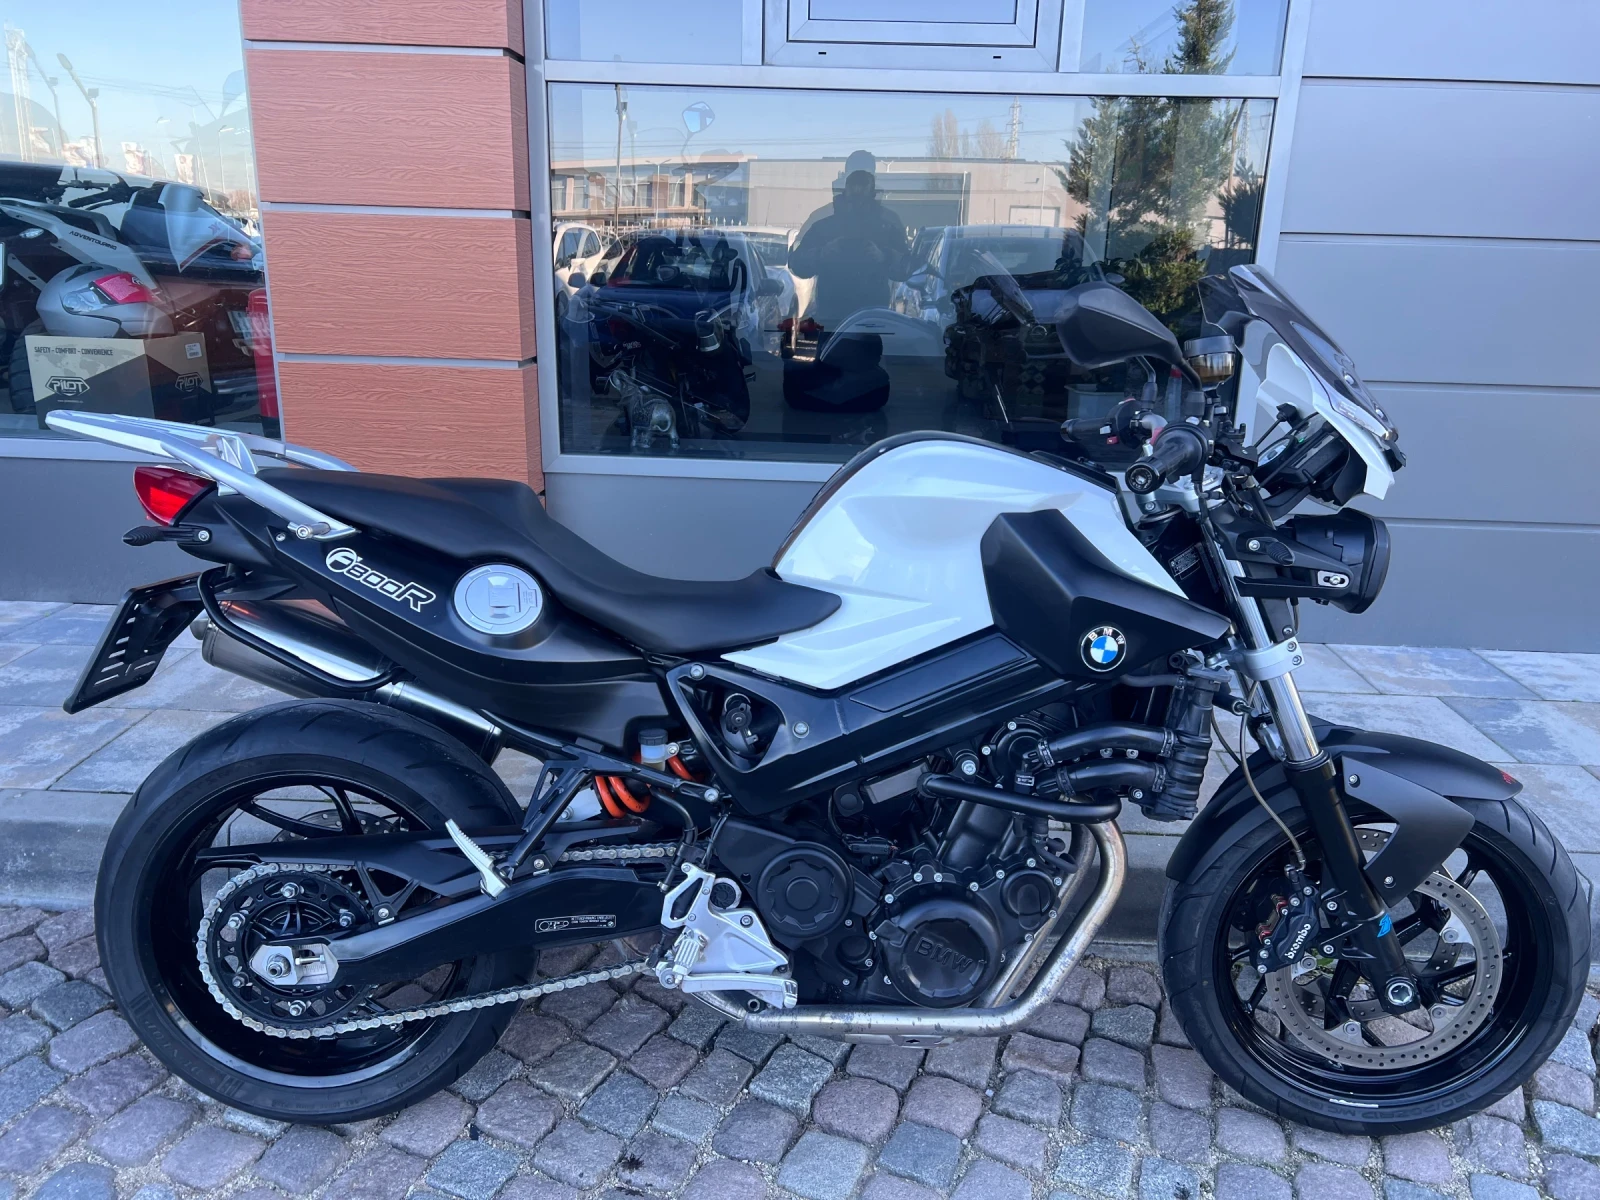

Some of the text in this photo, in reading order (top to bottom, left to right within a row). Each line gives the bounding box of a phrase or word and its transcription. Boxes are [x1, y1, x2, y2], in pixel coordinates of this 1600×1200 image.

[69, 230, 117, 250] ADVENTOURING
[34, 346, 51, 354] SAFETY
[55, 347, 77, 355] COMFORT
[81, 348, 114, 356] CONVENIENCE
[325, 547, 437, 613] F800R
[1087, 627, 1126, 646] BMW
[914, 936, 974, 974] BMW
[1284, 923, 1312, 960] brembo
